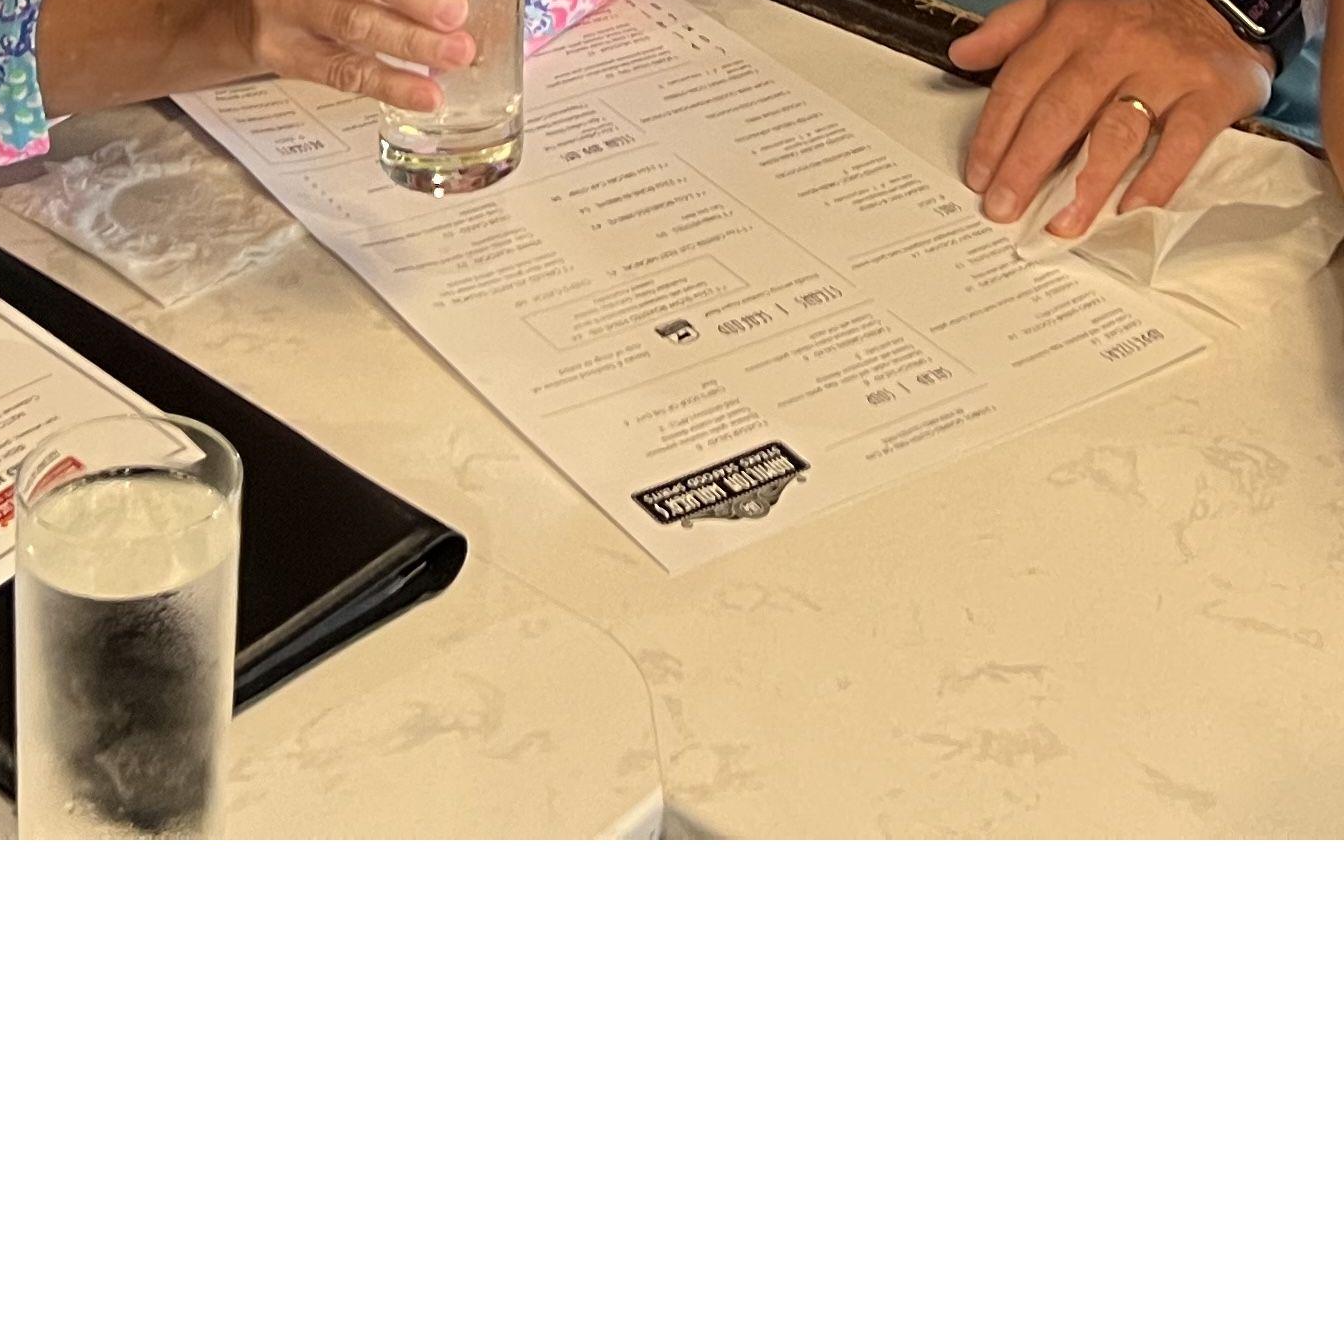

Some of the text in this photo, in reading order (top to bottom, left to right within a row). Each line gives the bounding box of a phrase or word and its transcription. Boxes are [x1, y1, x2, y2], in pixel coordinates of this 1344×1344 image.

[714, 285, 844, 336] STEAKS SEAFOOD
[1097, 329, 1166, 361] APPETIZERS
[863, 366, 953, 406] SALAD SOUP
[641, 446, 780, 503] STEAKS SEAFOOD SPIRITS
[721, 455, 796, 492] HAMILTON
[652, 481, 726, 518] WALKER'S
